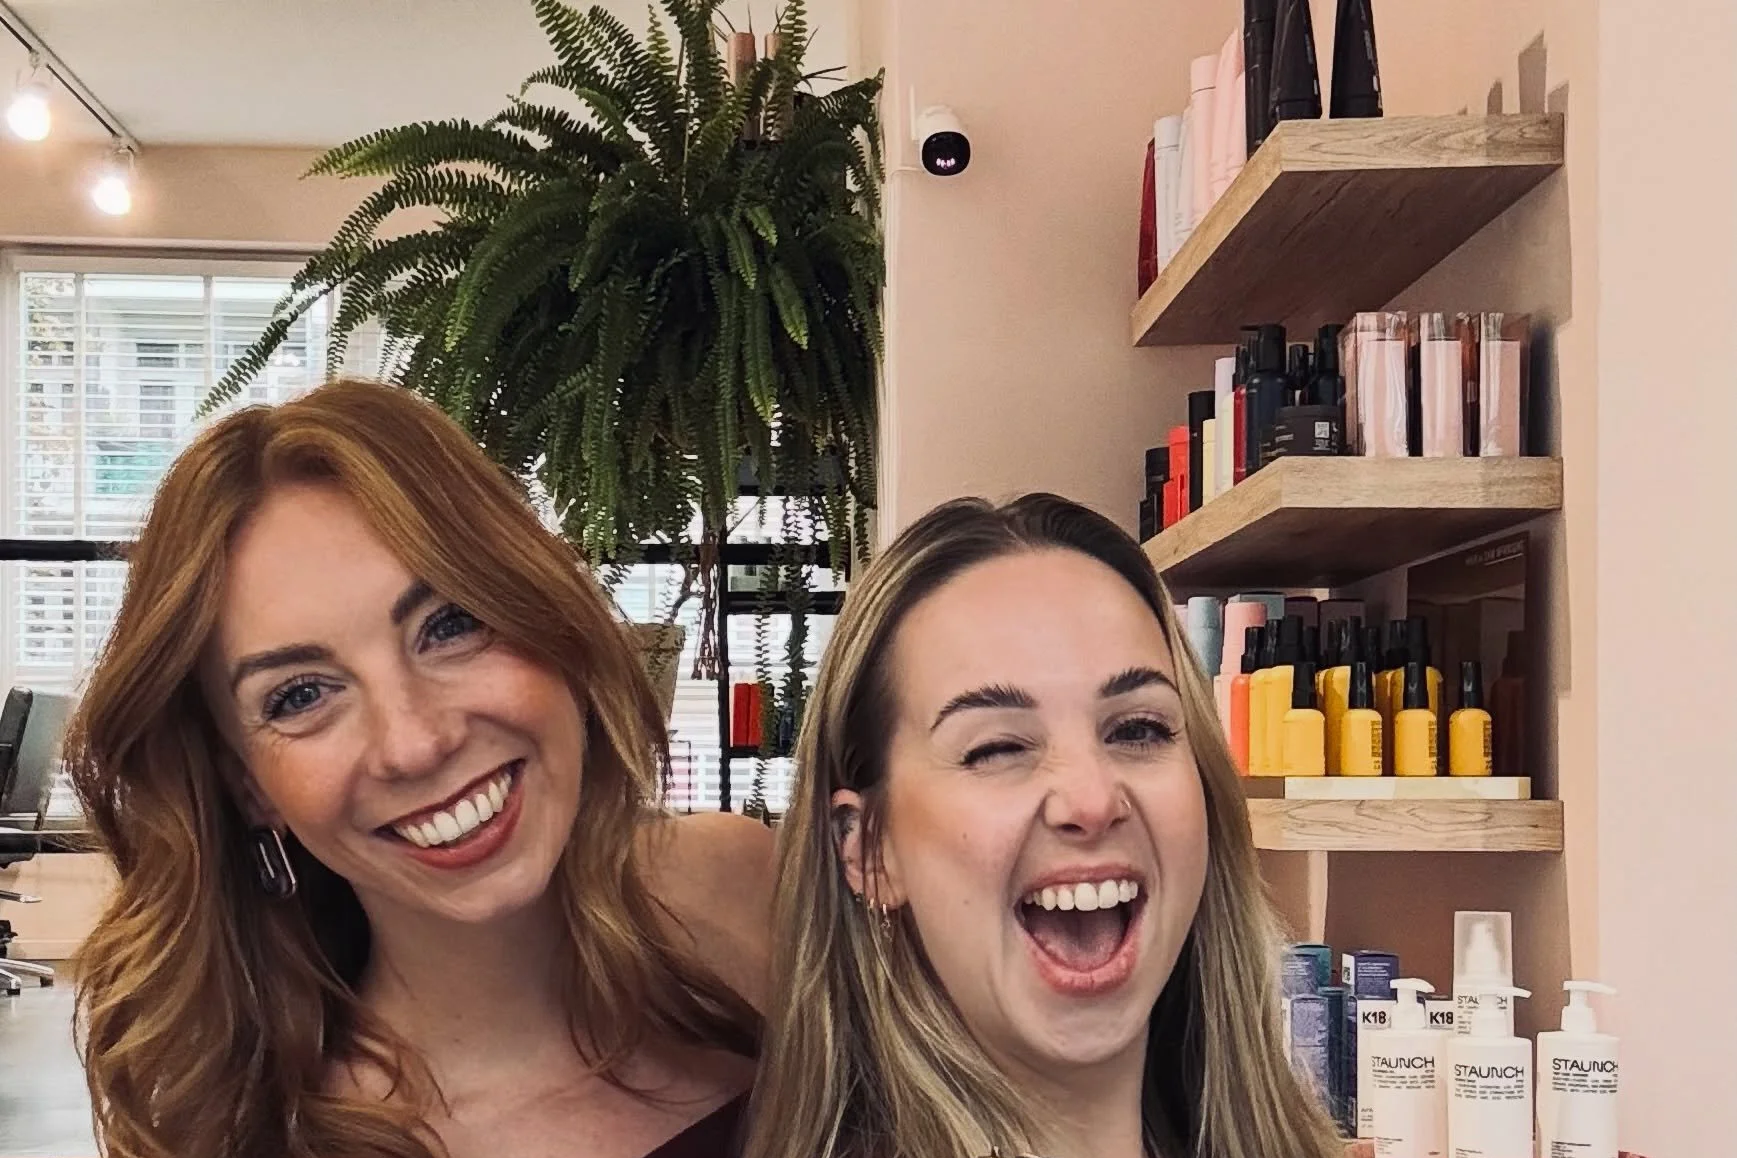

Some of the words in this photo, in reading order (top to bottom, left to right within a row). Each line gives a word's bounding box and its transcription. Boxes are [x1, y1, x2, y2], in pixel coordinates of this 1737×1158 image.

[1362, 1010, 1387, 1025] K18
[1429, 1011, 1454, 1025] K18
[1371, 1055, 1435, 1069] STAUNCH
[1552, 1058, 1619, 1073] STAUNCH
[1454, 1064, 1525, 1079] STAUNCH
